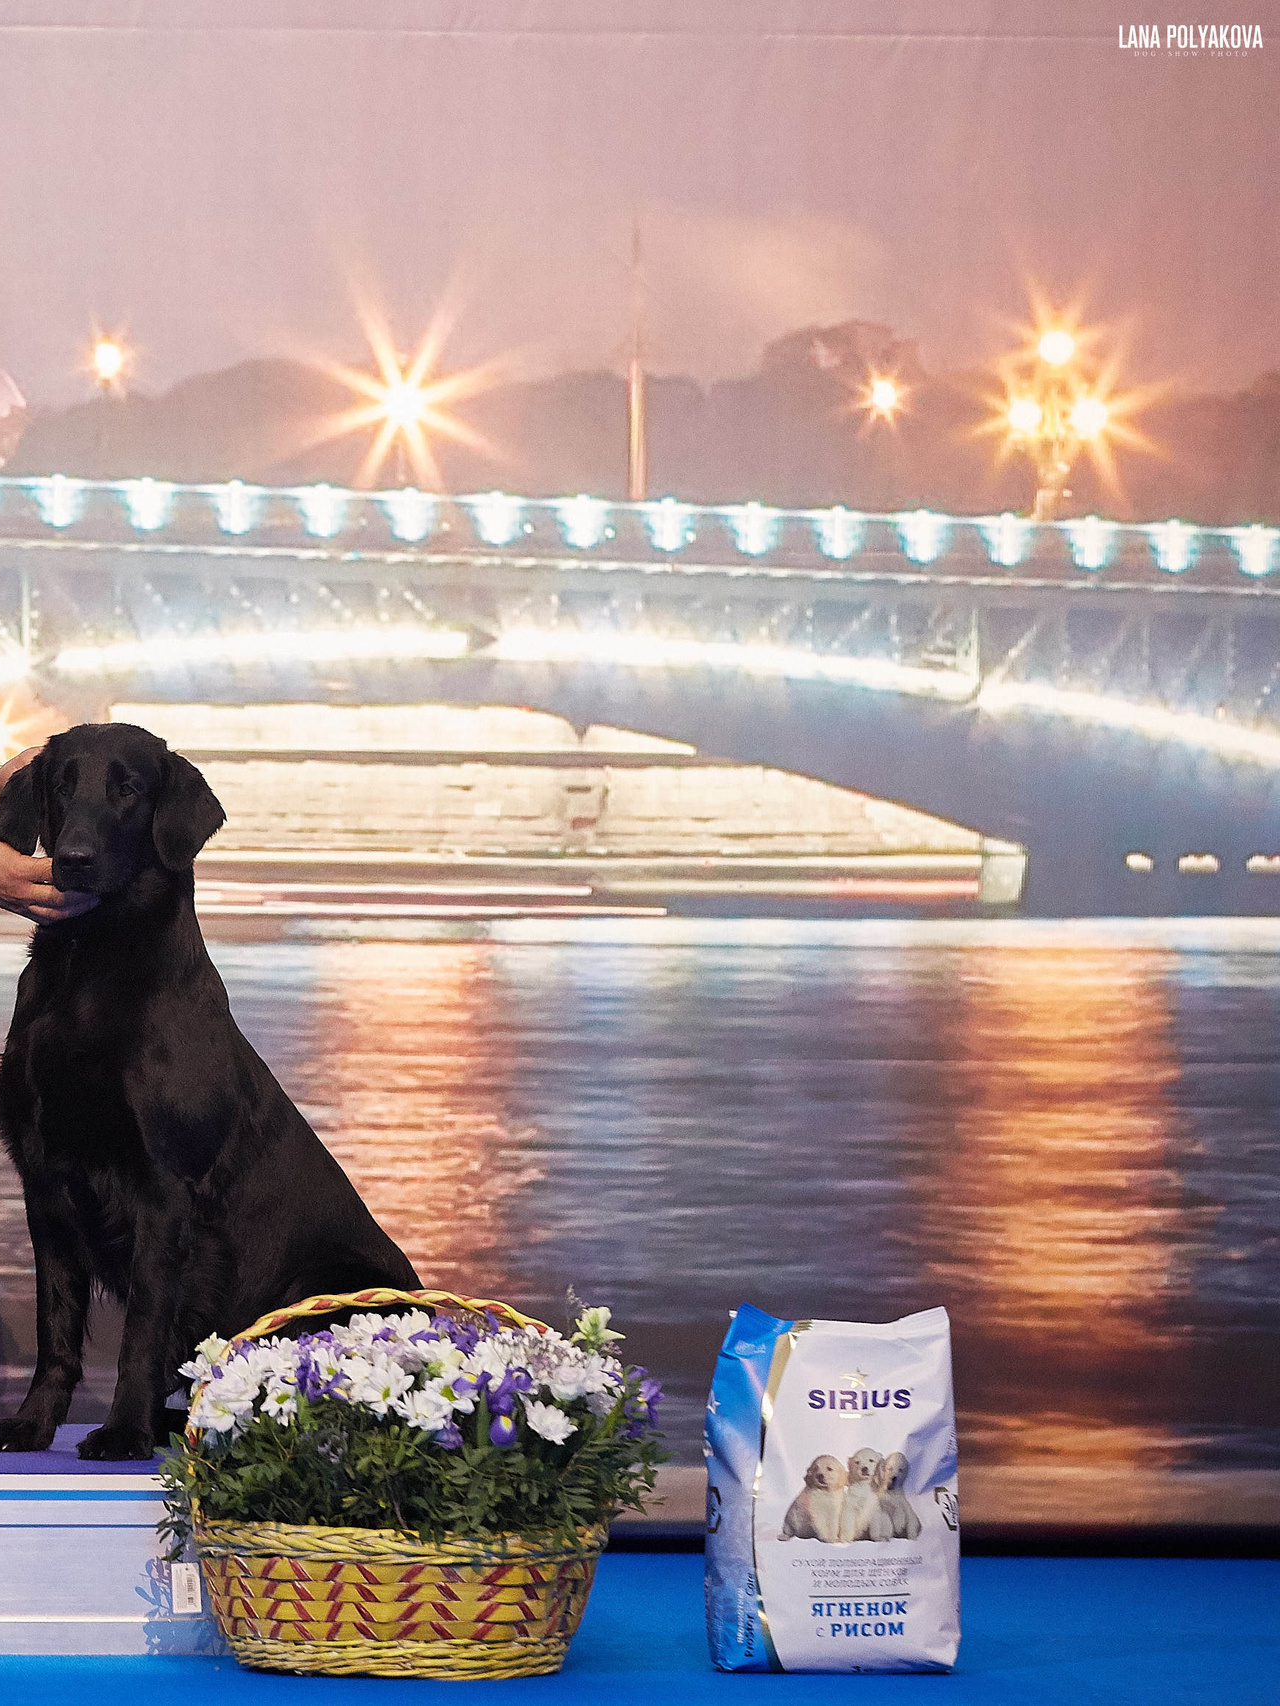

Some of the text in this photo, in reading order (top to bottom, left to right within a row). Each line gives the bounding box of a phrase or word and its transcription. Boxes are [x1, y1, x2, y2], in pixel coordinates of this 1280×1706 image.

[807, 1389, 912, 1410] SIRIUS
[811, 1601, 908, 1617] ЯГНЕНОК
[830, 1622, 905, 1637] РИСОМ
